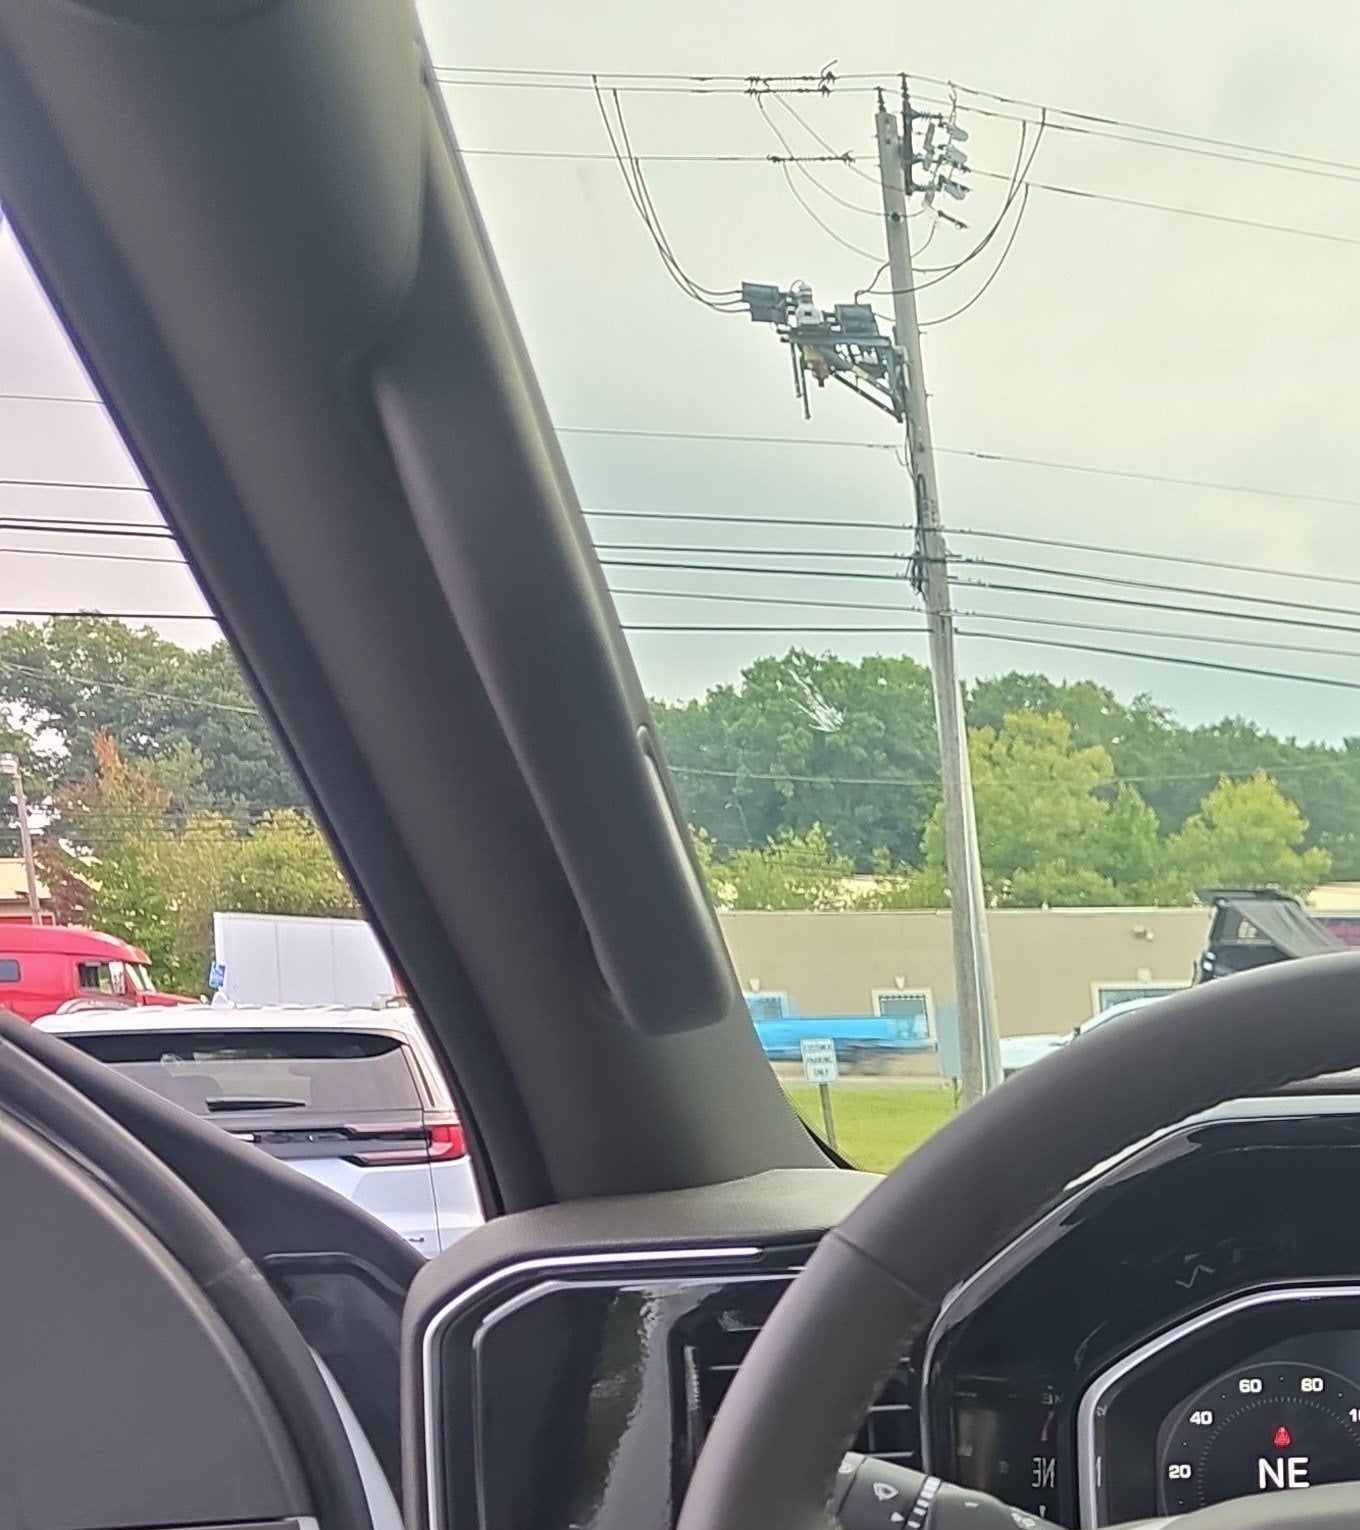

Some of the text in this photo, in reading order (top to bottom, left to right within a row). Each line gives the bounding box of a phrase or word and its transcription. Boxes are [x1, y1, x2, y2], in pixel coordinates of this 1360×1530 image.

[1238, 1378, 1263, 1394] 60
[1300, 1377, 1325, 1393] 80
[1189, 1410, 1213, 1425] 40
[1168, 1464, 1192, 1479] 20
[1258, 1457, 1310, 1489] NE
